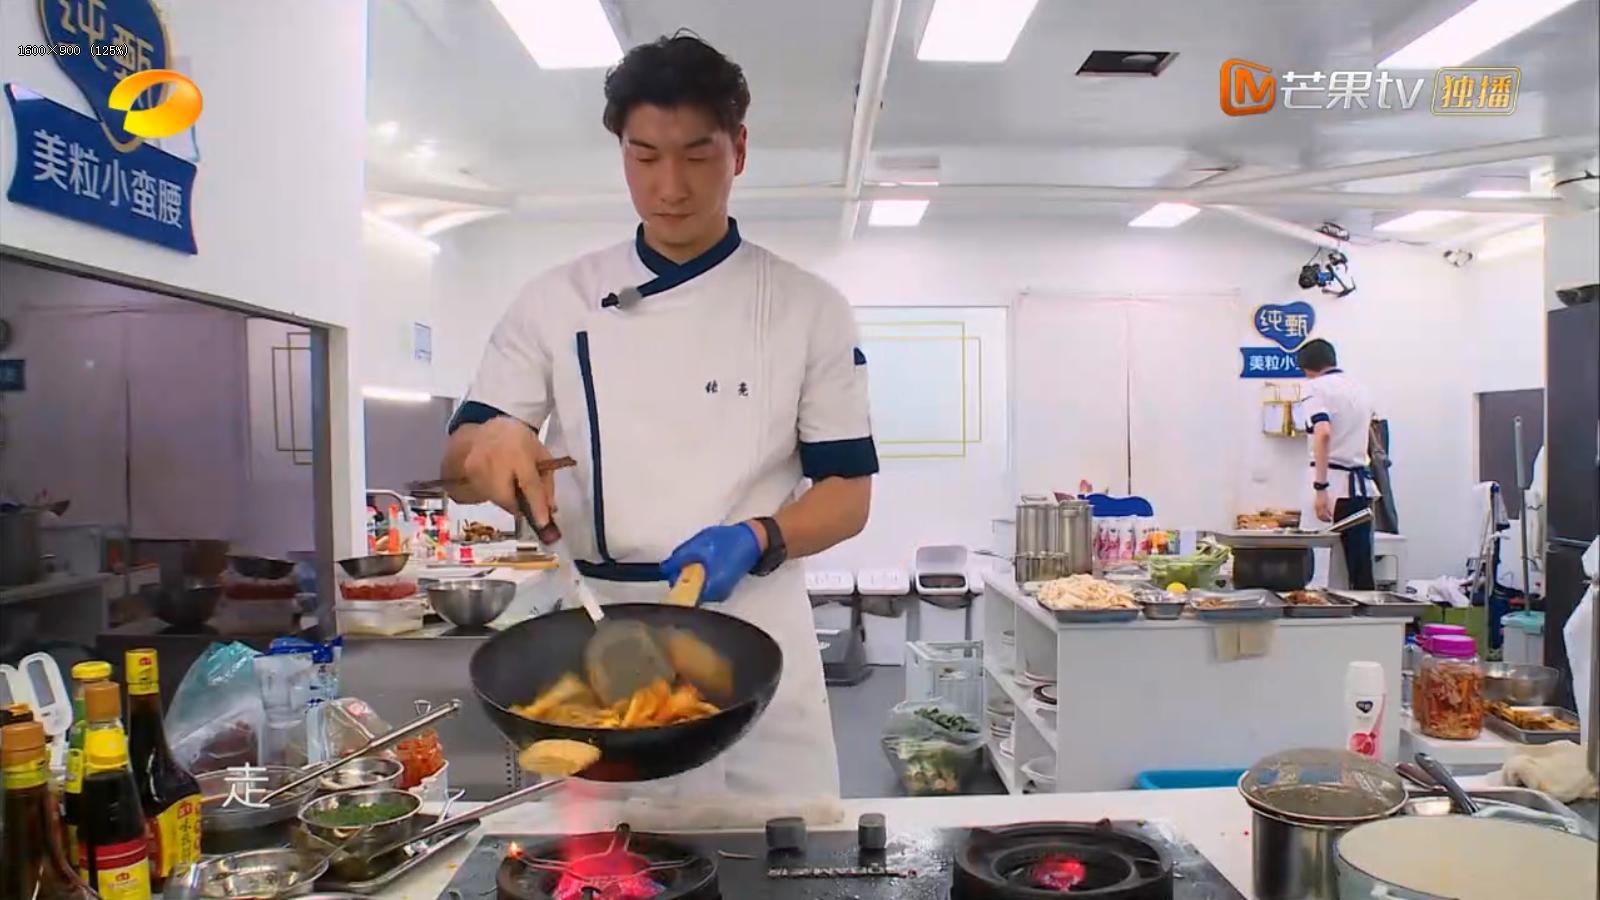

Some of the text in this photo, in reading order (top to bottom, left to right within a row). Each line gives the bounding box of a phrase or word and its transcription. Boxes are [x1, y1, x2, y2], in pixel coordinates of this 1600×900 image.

[33, 128, 183, 229] 美粒小蛮腰
[1260, 309, 1309, 337] 纯甄
[1249, 355, 1301, 371] 美粒小
